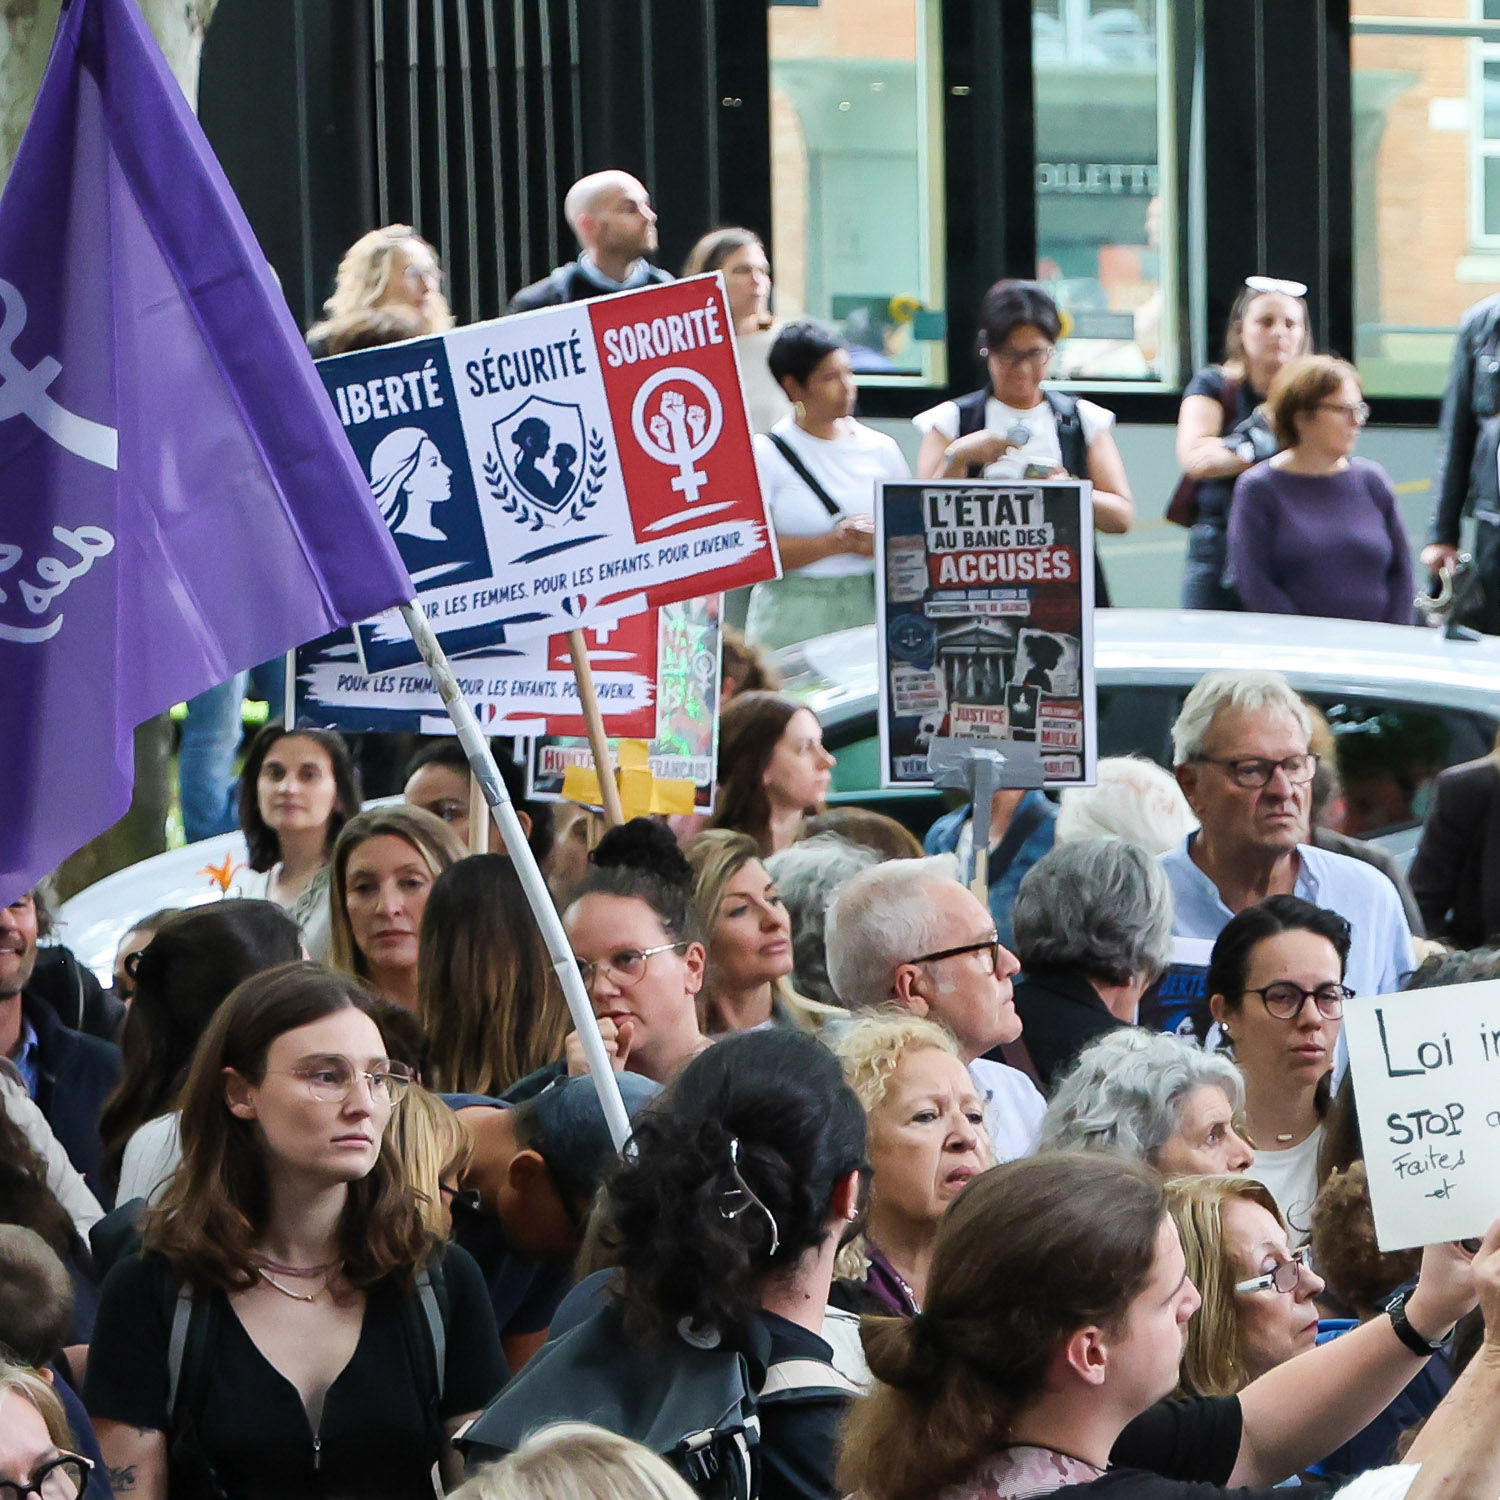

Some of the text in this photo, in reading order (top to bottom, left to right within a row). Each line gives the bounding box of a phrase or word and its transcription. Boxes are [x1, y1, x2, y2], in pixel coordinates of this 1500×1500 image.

[602, 298, 726, 368] SORORITÉ
[465, 330, 588, 398] SÉCURITÉ
[335, 358, 445, 427] IBERTÉ
[929, 487, 1035, 528] L'ÉTAT
[934, 528, 1048, 549] AU BANC DES
[446, 598, 467, 615] LES
[473, 583, 530, 611] FEMMES.
[534, 576, 567, 593] POUR
[572, 568, 594, 587] LES
[600, 557, 654, 582] ENFANTS.
[658, 548, 690, 566] POUR
[938, 545, 1072, 585] ACCUSÉS
[373, 676, 394, 693] LES
[487, 679, 509, 697] LES
[1374, 1007, 1454, 1078] Loi
[1386, 1102, 1466, 1145] STOP
[1424, 1179, 1457, 1200] et
